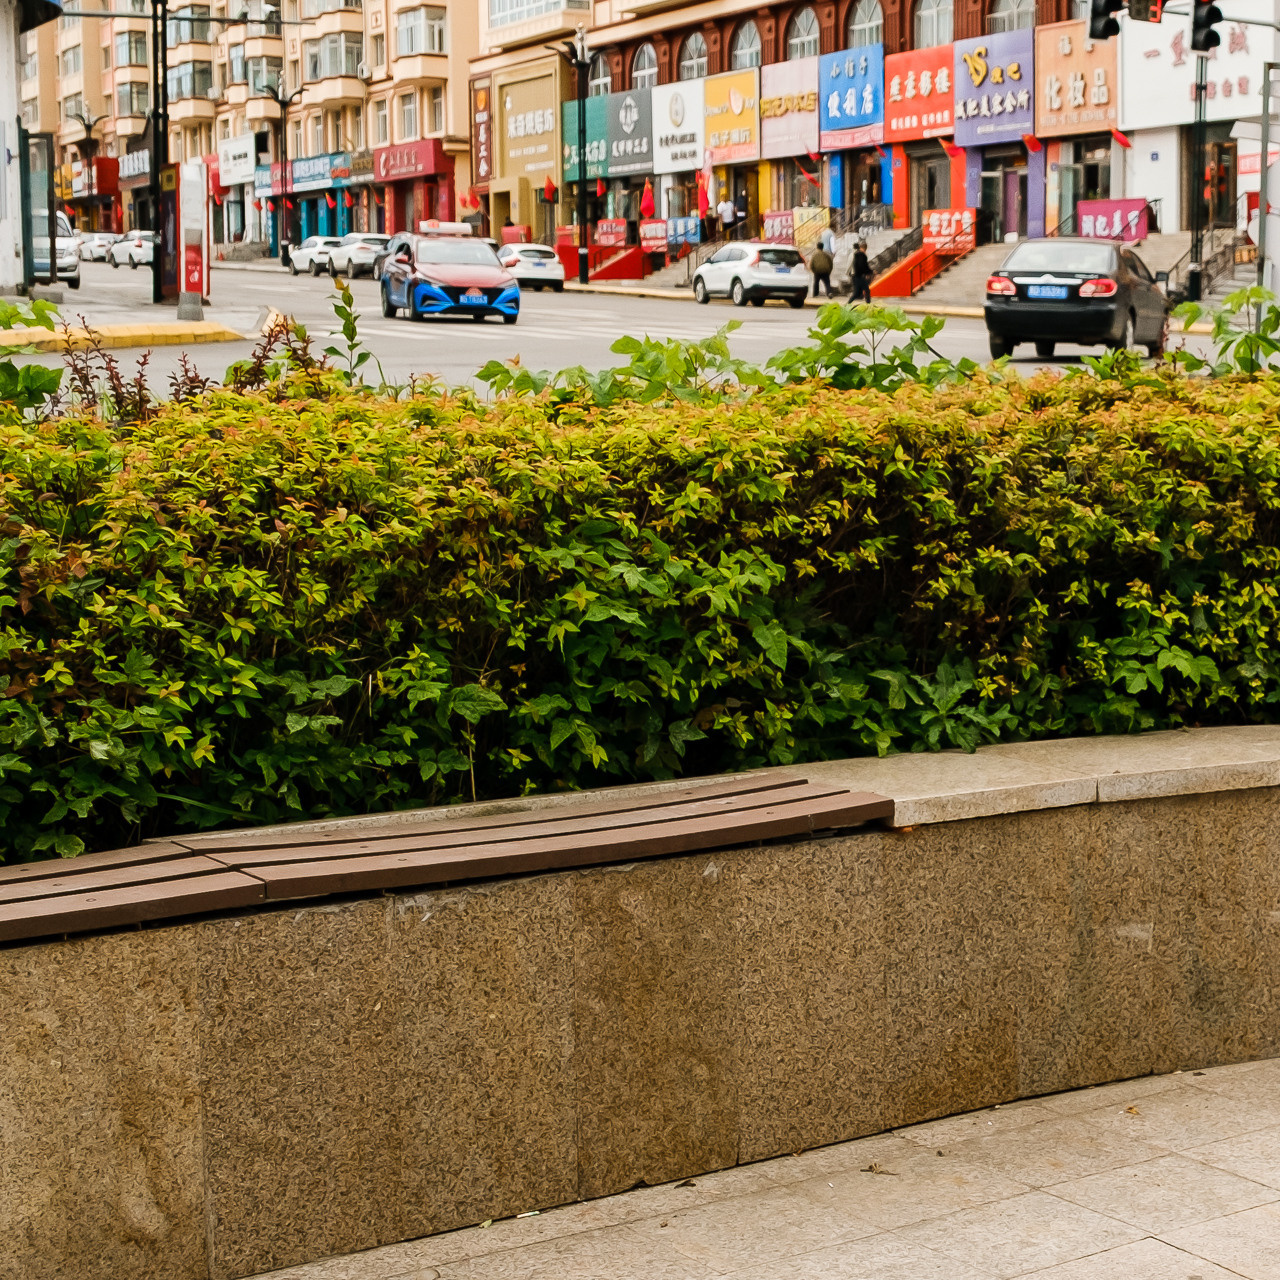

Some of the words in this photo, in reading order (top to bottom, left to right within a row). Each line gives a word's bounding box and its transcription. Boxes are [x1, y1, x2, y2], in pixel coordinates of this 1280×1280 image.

[828, 83, 873, 118] 便利店
[1045, 67, 1109, 111] 化妆品
